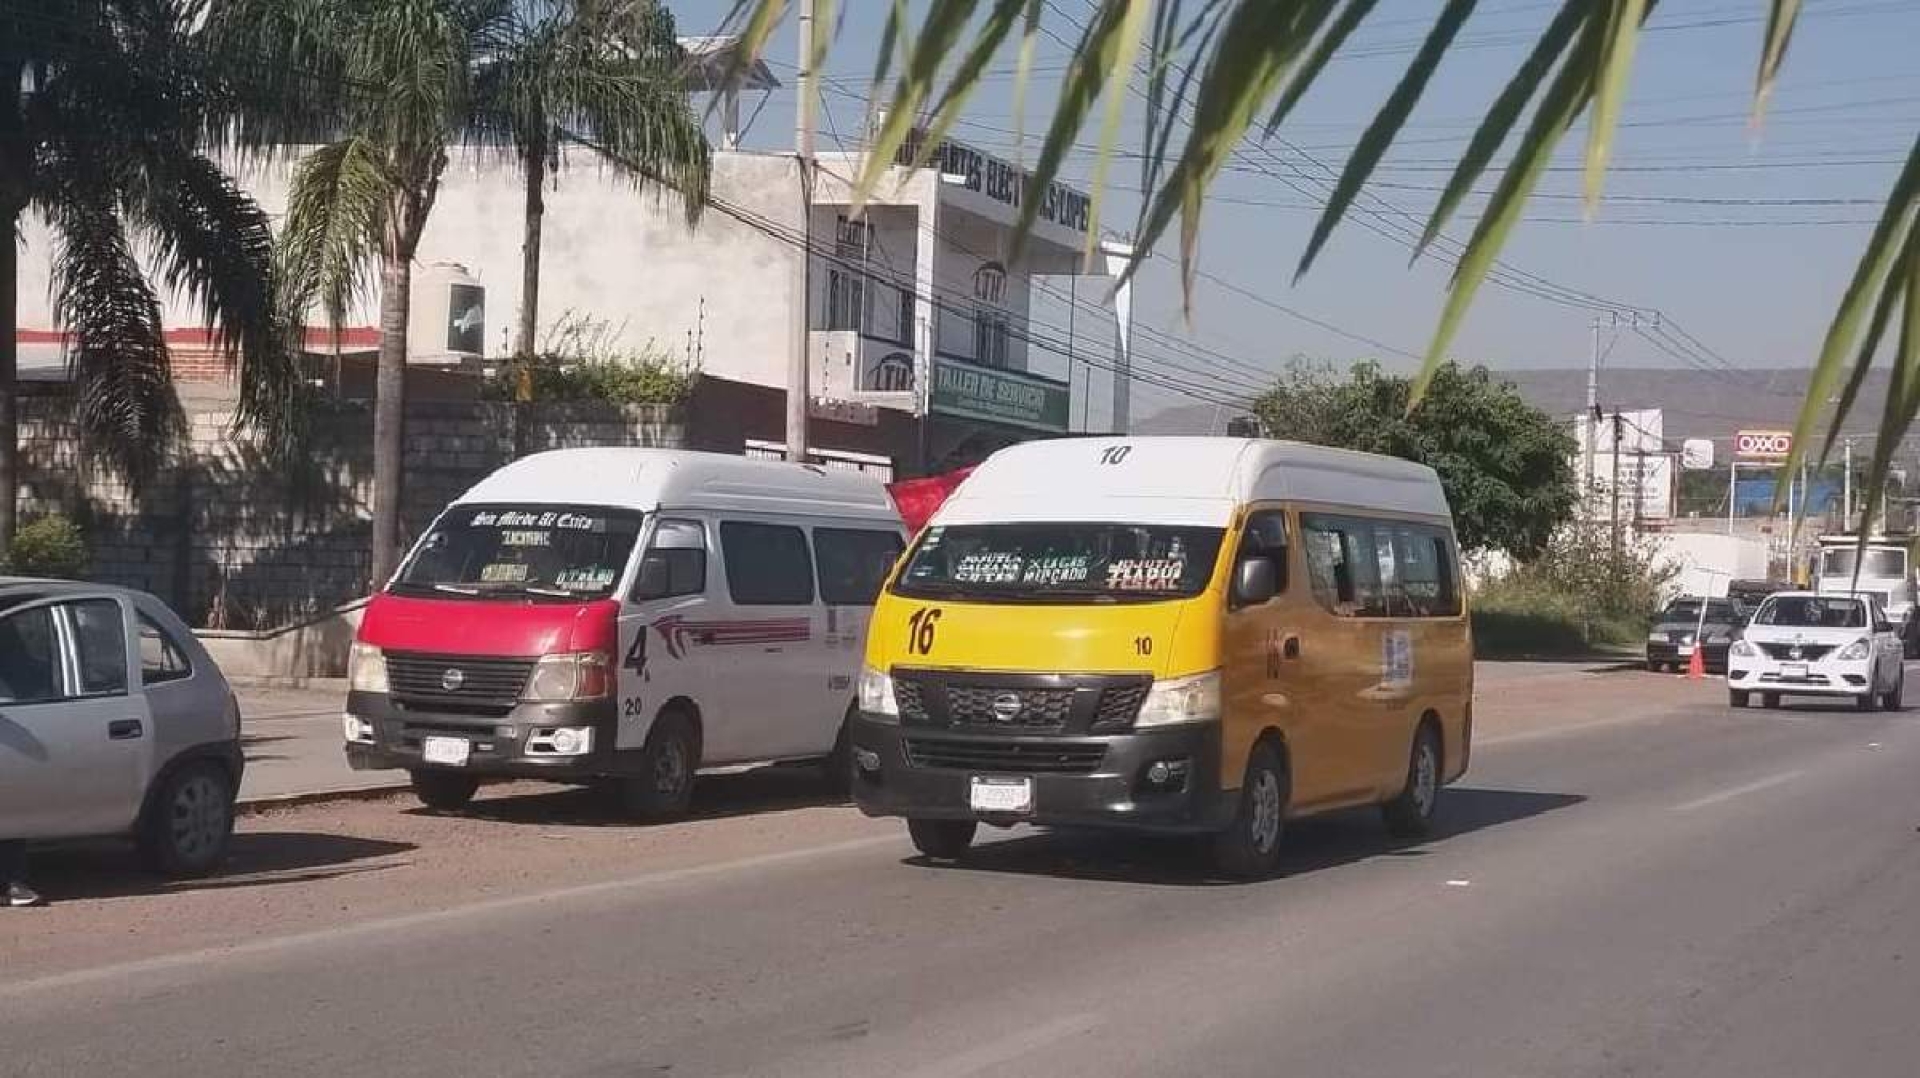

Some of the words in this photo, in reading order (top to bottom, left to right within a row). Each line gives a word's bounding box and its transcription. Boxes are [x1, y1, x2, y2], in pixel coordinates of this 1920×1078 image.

[1739, 436, 1790, 452] OXXO
[1101, 445, 1132, 465] 10
[908, 607, 942, 655] 16
[623, 625, 648, 676] 4
[1133, 636, 1152, 656] 10
[625, 696, 642, 716] 20
